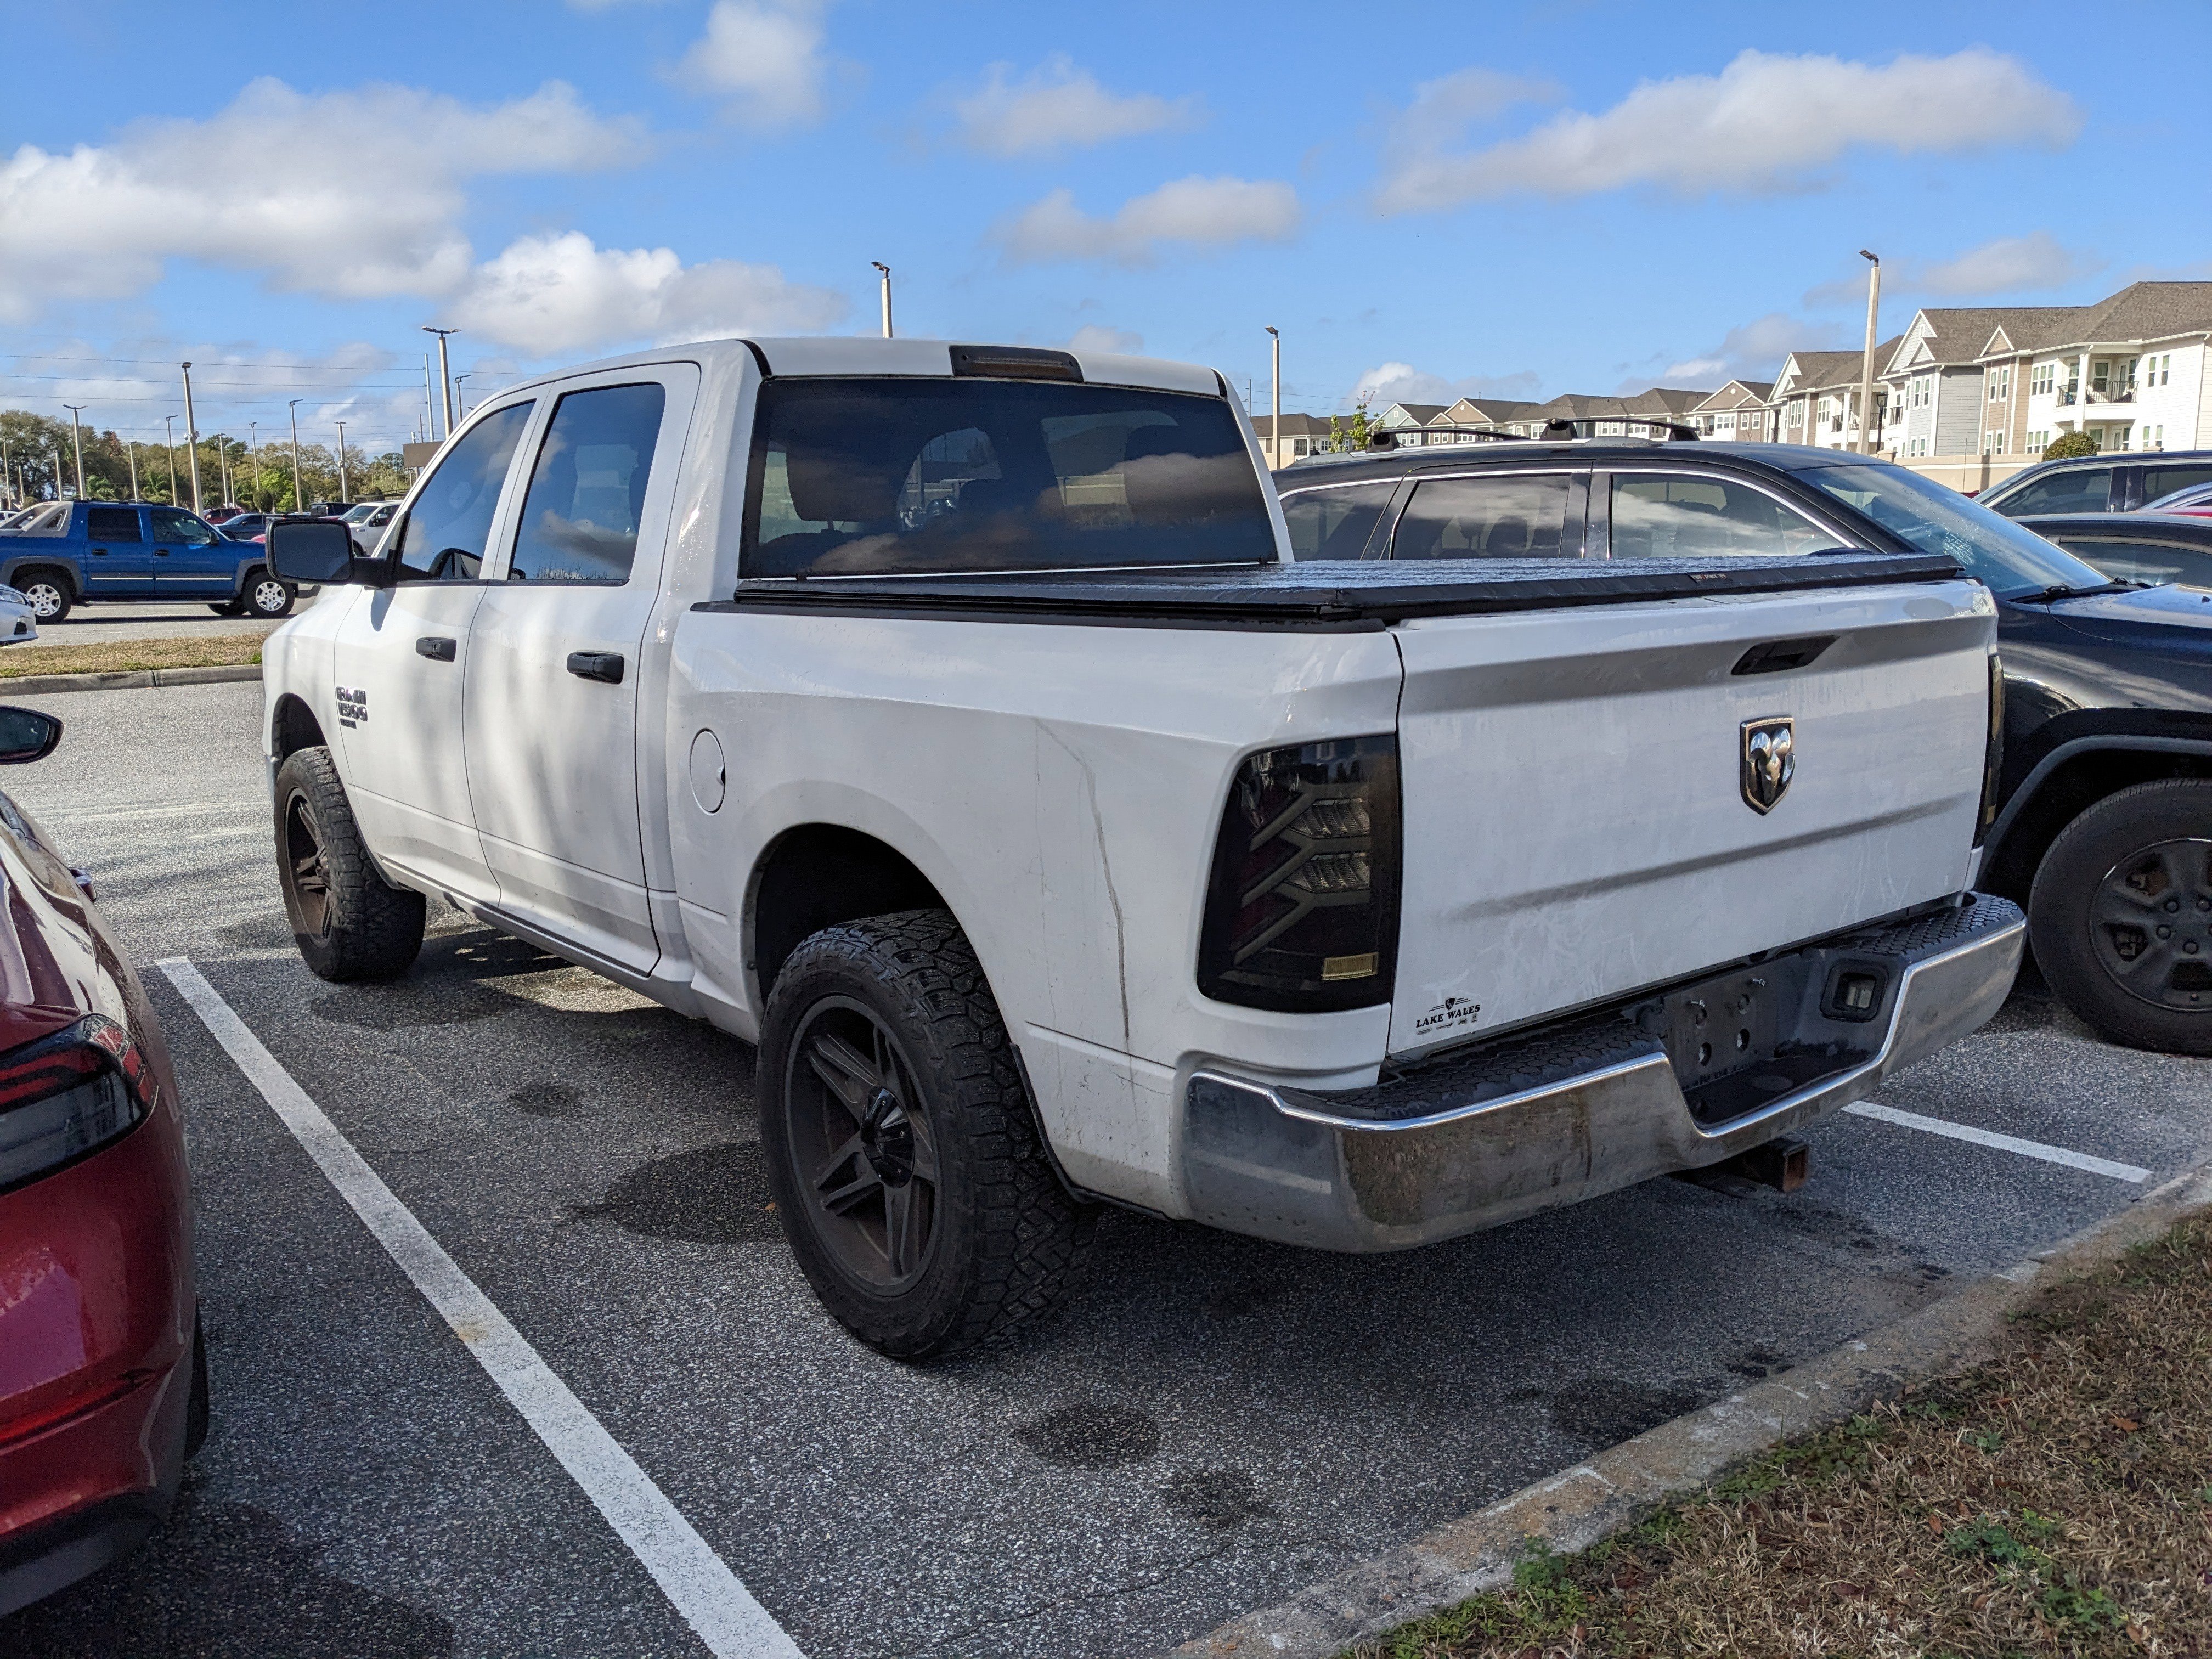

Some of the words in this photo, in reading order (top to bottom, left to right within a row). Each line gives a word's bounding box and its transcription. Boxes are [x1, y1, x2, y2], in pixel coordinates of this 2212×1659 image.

[336, 686, 366, 706] RAM
[338, 702, 368, 722] 1500
[1416, 1014, 1444, 1028] LAKE
[1447, 1004, 1481, 1019] WALES
